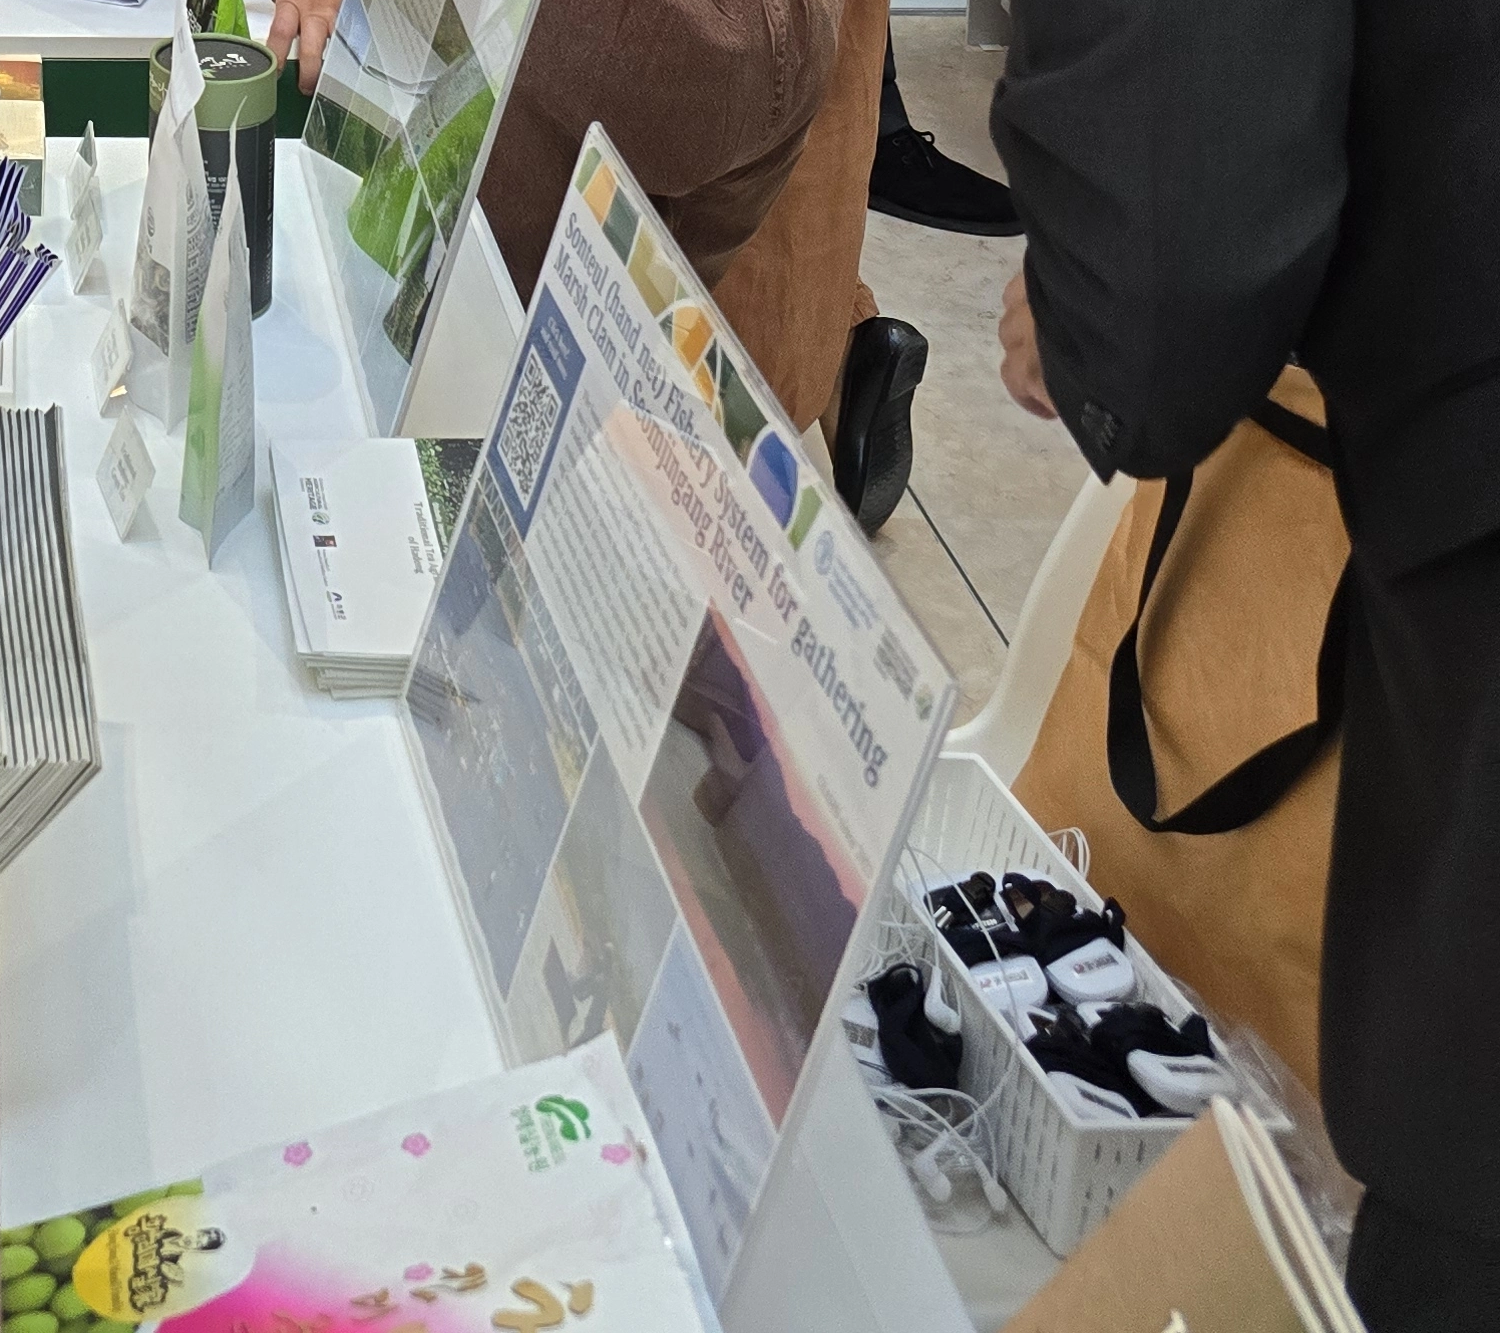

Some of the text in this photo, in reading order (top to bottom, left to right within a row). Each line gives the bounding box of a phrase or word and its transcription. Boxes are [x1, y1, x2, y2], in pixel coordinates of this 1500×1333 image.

[553, 244, 590, 320] Marsh
[586, 308, 618, 372] Clam
[614, 350, 632, 397] in
[707, 523, 754, 614] River
[564, 211, 609, 299] Sonteul
[604, 282, 644, 360] (hand
[639, 344, 670, 398] net)
[663, 390, 719, 487] Fishery
[713, 465, 771, 581] System
[766, 561, 799, 627] for
[790, 615, 889, 789] gathering
